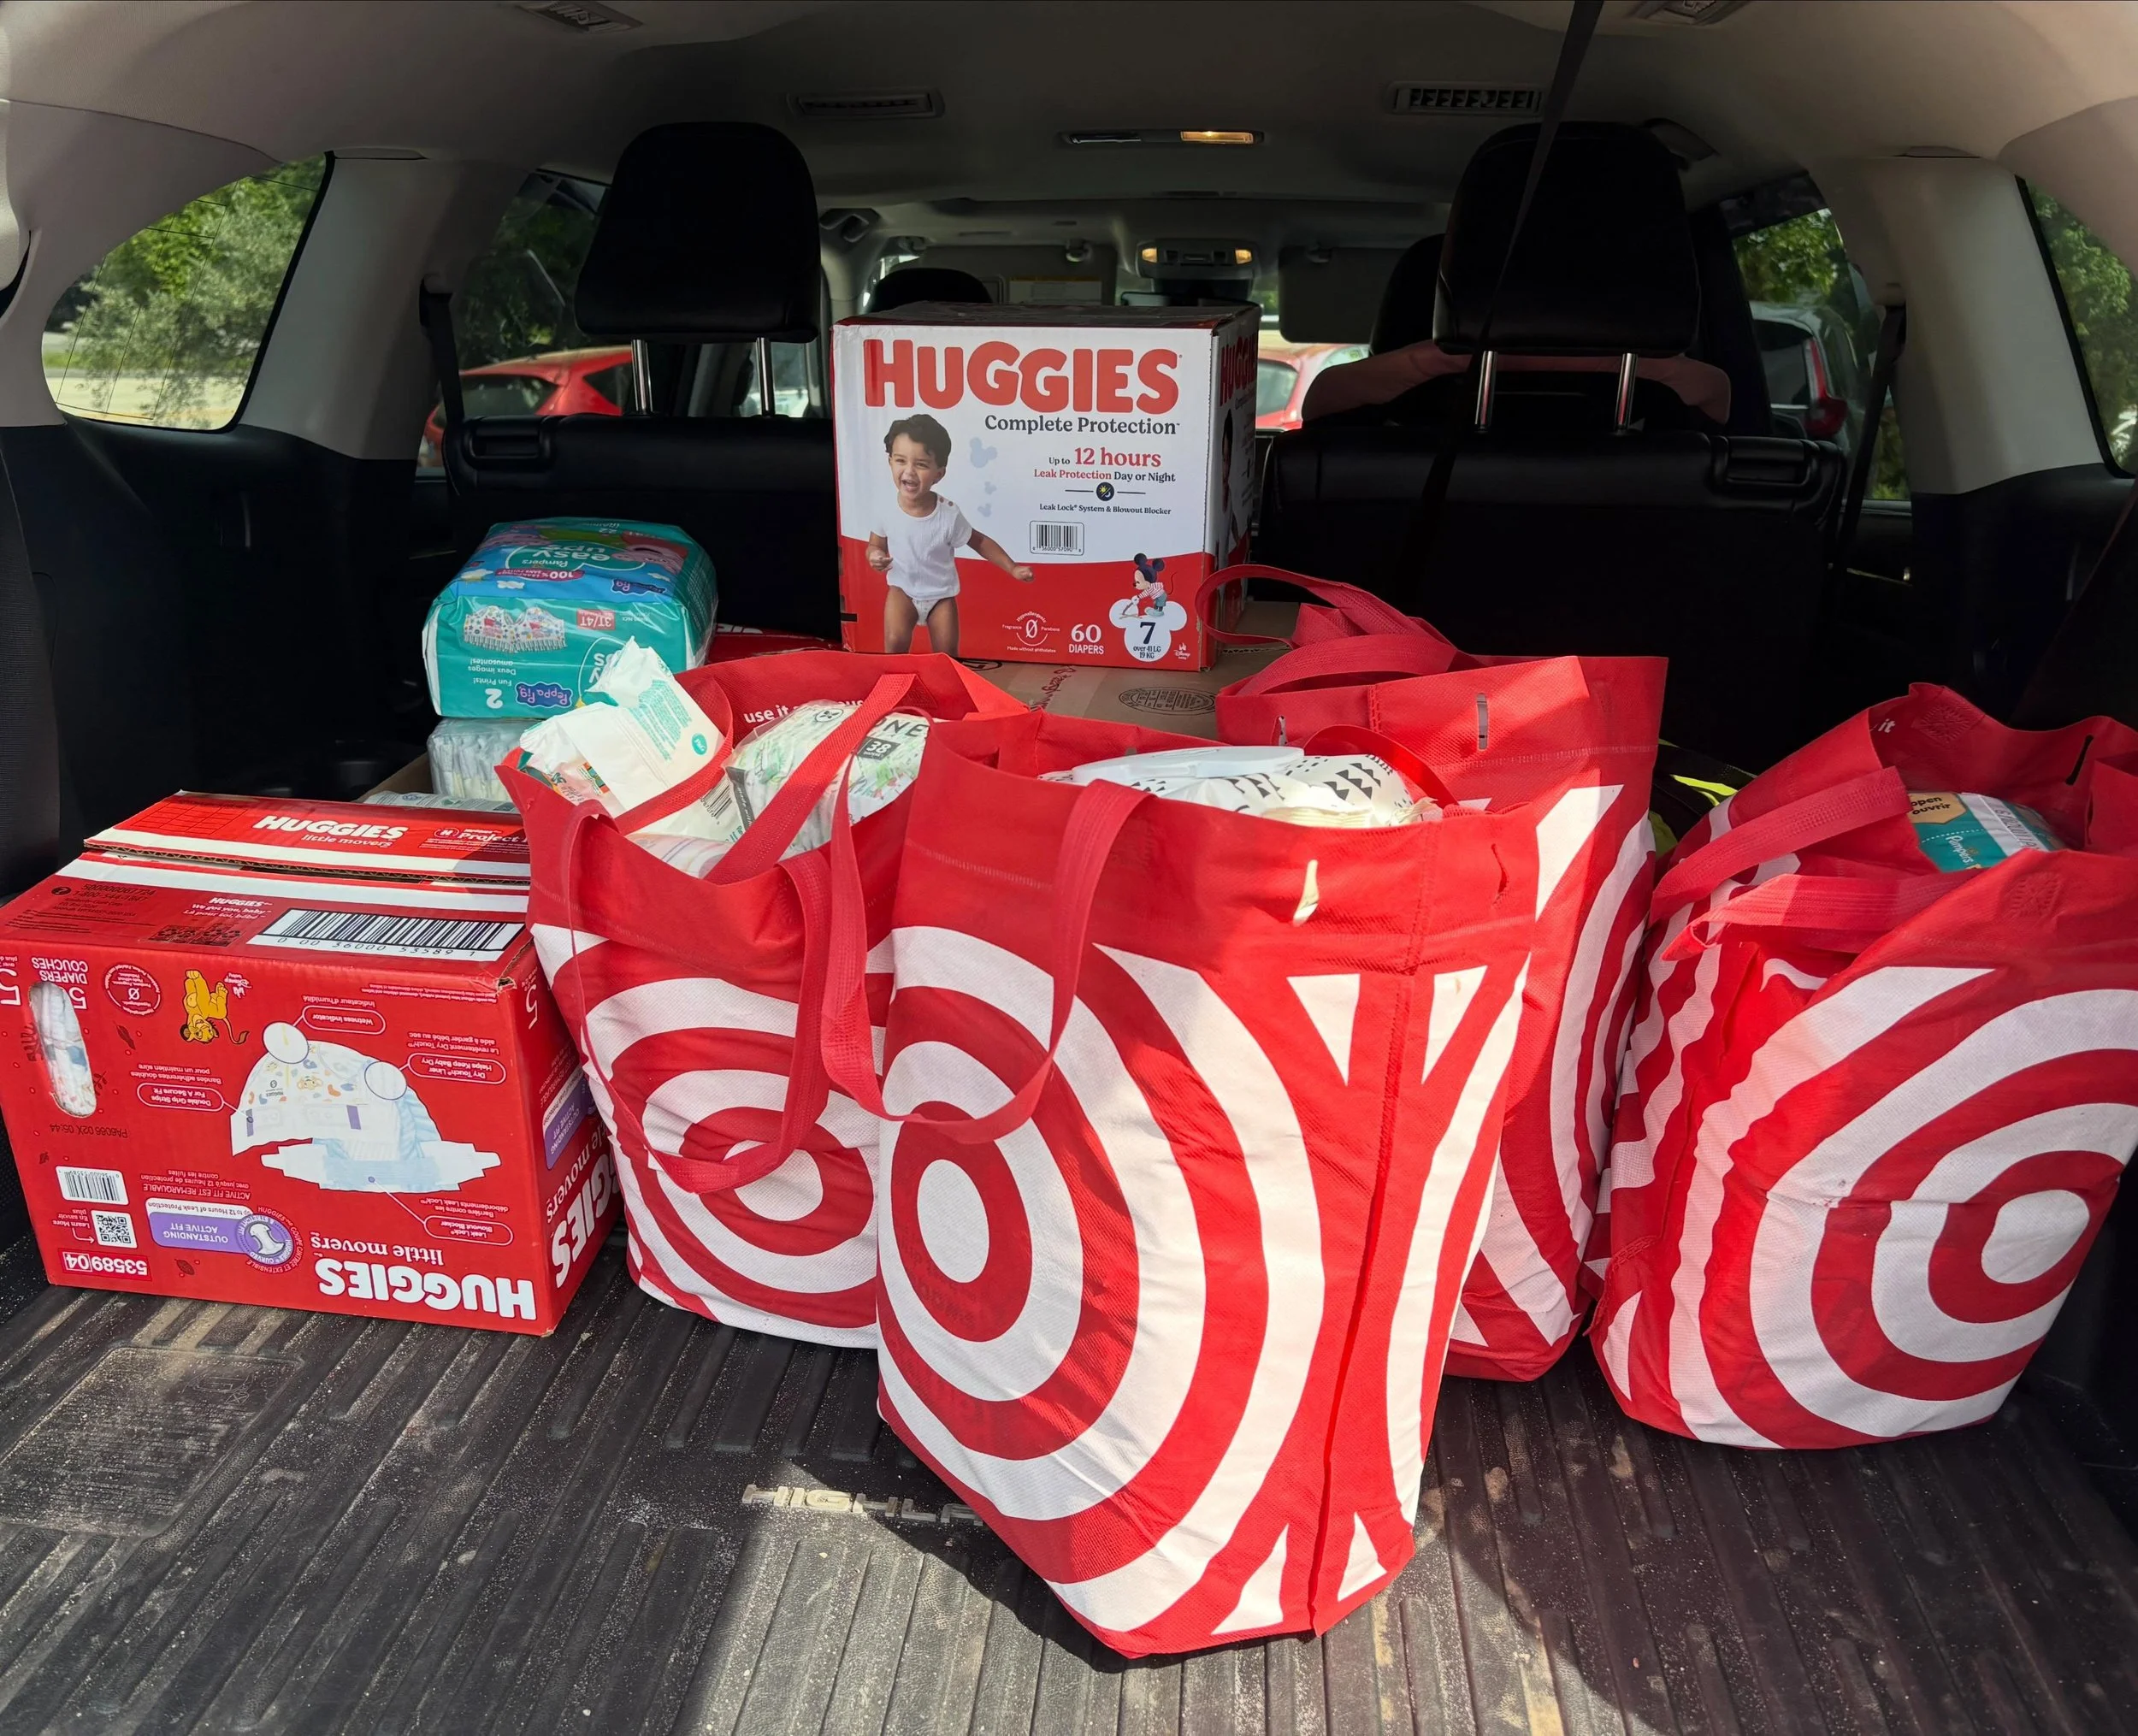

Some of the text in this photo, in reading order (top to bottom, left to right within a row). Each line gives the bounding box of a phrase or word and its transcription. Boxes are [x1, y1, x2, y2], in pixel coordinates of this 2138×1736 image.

[864, 340, 1178, 414] HUGGIES
[985, 415, 1072, 434] Complete
[1075, 447, 1095, 464] 12
[1100, 447, 1161, 467] hours
[1060, 470, 1112, 479] Protection
[1113, 472, 1133, 482] Day
[1149, 473, 1175, 483] Night
[532, 549, 611, 561] easy
[580, 615, 611, 627] 3T/4T
[1072, 623, 1101, 643] 60
[1140, 622, 1155, 644] 7
[1069, 644, 1104, 654] DIAPERS
[468, 665, 495, 674] images
[485, 688, 503, 708] 2
[519, 688, 568, 705] Peppa Pig
[744, 707, 773, 723] use
[866, 741, 891, 753] 38
[1912, 803, 1951, 815] ouvrir
[253, 815, 408, 840] HUGGIES
[302, 835, 393, 847] little movers
[458, 833, 520, 842] Project
[1946, 835, 1974, 864] Pampers
[31, 957, 88, 971] COUCHES
[39, 970, 87, 984] DIAPERS
[0, 968, 21, 1005] 5
[340, 998, 375, 1007] Indicateur
[526, 983, 537, 1030] 5
[312, 1014, 373, 1025] Wetness Indicator
[433, 1034, 450, 1042] bébé
[436, 1042, 449, 1050] Dry
[421, 1057, 492, 1071] Helps Keep Baby Dry
[428, 1067, 486, 1079] Dry Liner
[197, 1076, 221, 1084] Bandes
[151, 1094, 211, 1107] Double Grip Strips
[144, 1184, 196, 1195] REMARQUABLE
[546, 1146, 590, 1223] movers
[226, 1190, 250, 1199] ACTIVE
[148, 1202, 181, 1211] Protection
[444, 1199, 509, 1213] débordements Leak
[468, 1208, 494, 1218] Barrière
[170, 1222, 217, 1233] ACTIVE FIT
[440, 1220, 493, 1232] Blowout Blocker
[162, 1231, 228, 1243] OUTSTANDING
[291, 1227, 303, 1246] COUPE
[471, 1230, 487, 1238] Leak
[311, 1235, 444, 1266] little movers
[246, 1260, 283, 1273] EXTENSIBLE
[315, 1258, 536, 1320] HUGGIES
